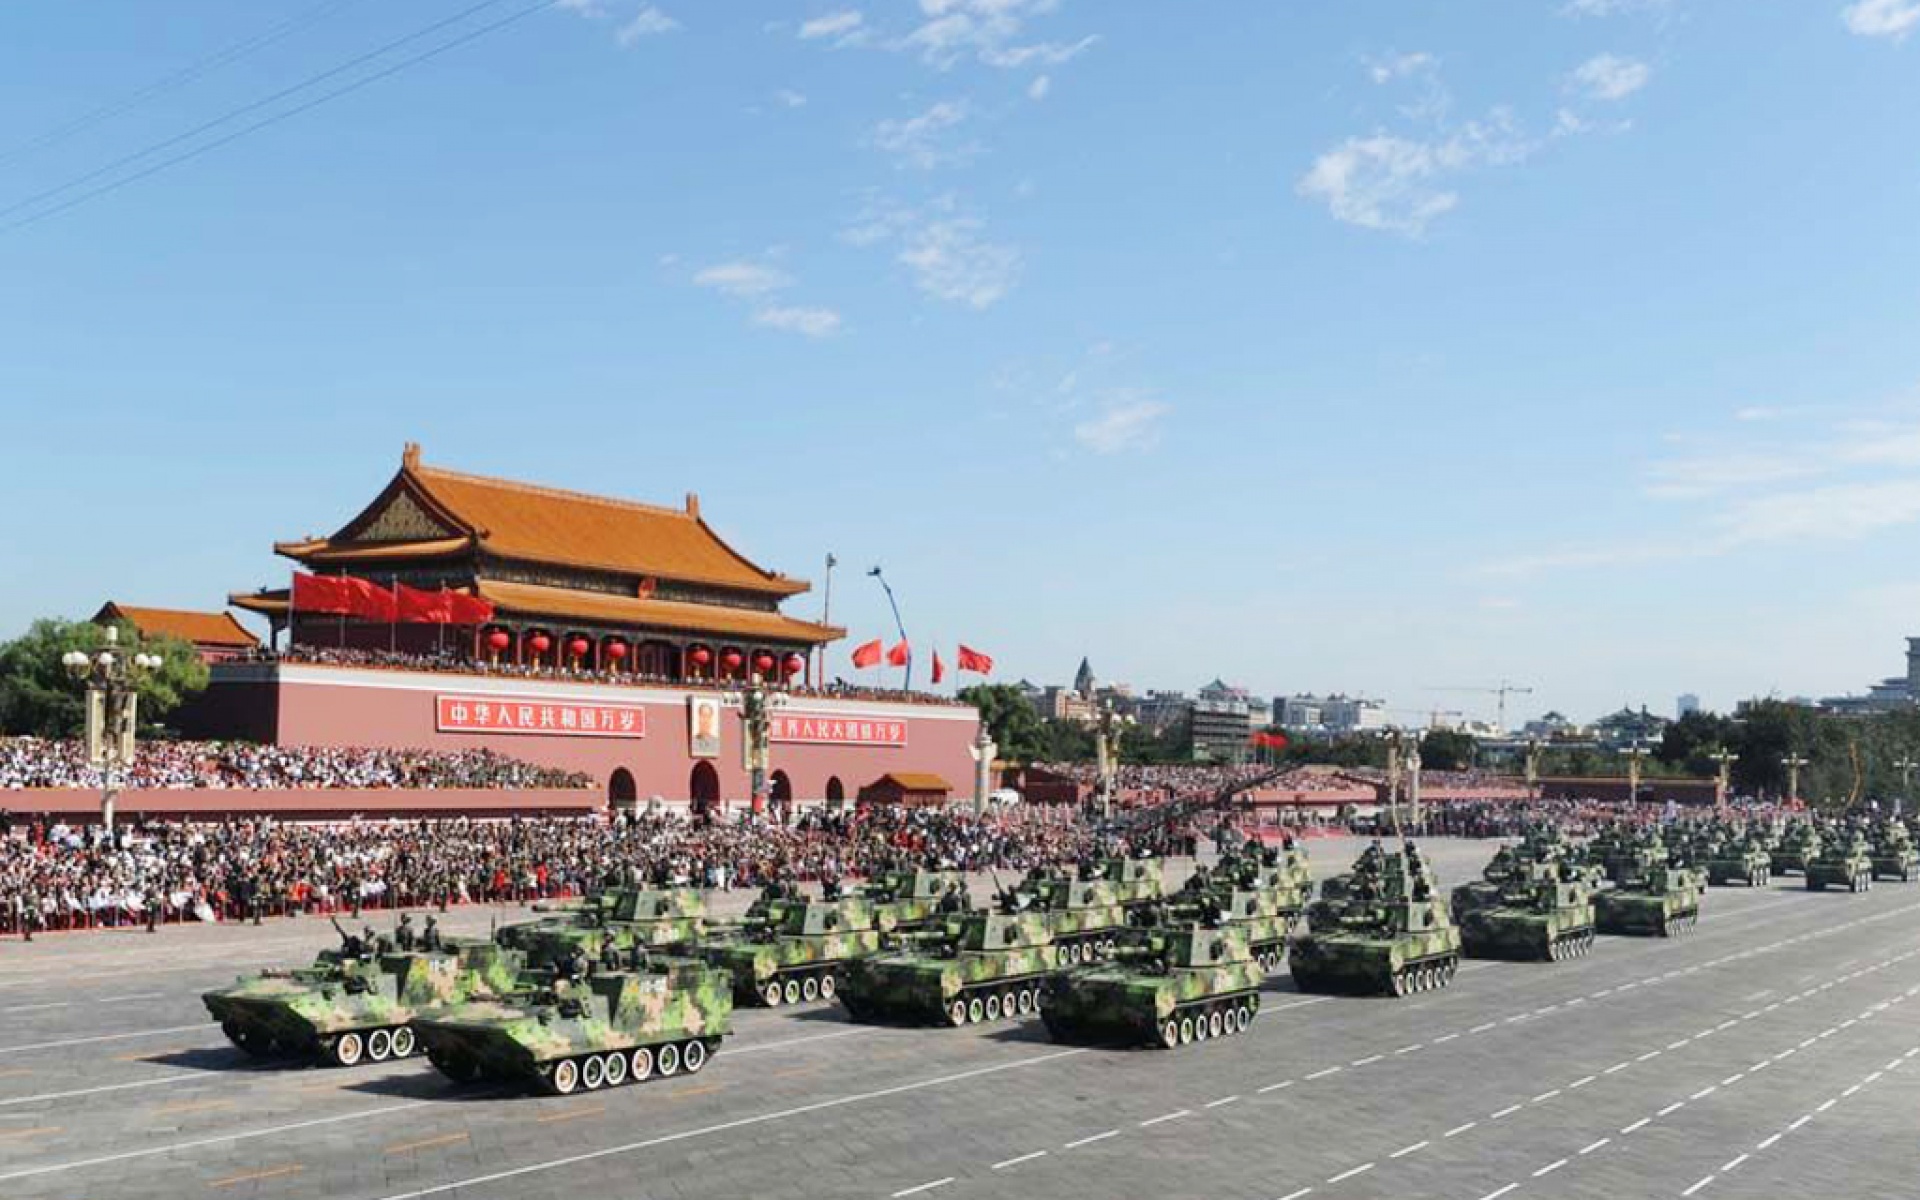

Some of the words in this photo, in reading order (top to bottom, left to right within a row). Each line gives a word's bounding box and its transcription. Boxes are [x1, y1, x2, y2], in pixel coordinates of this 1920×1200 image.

[450, 702, 635, 731] 中华人民共和国万岁
